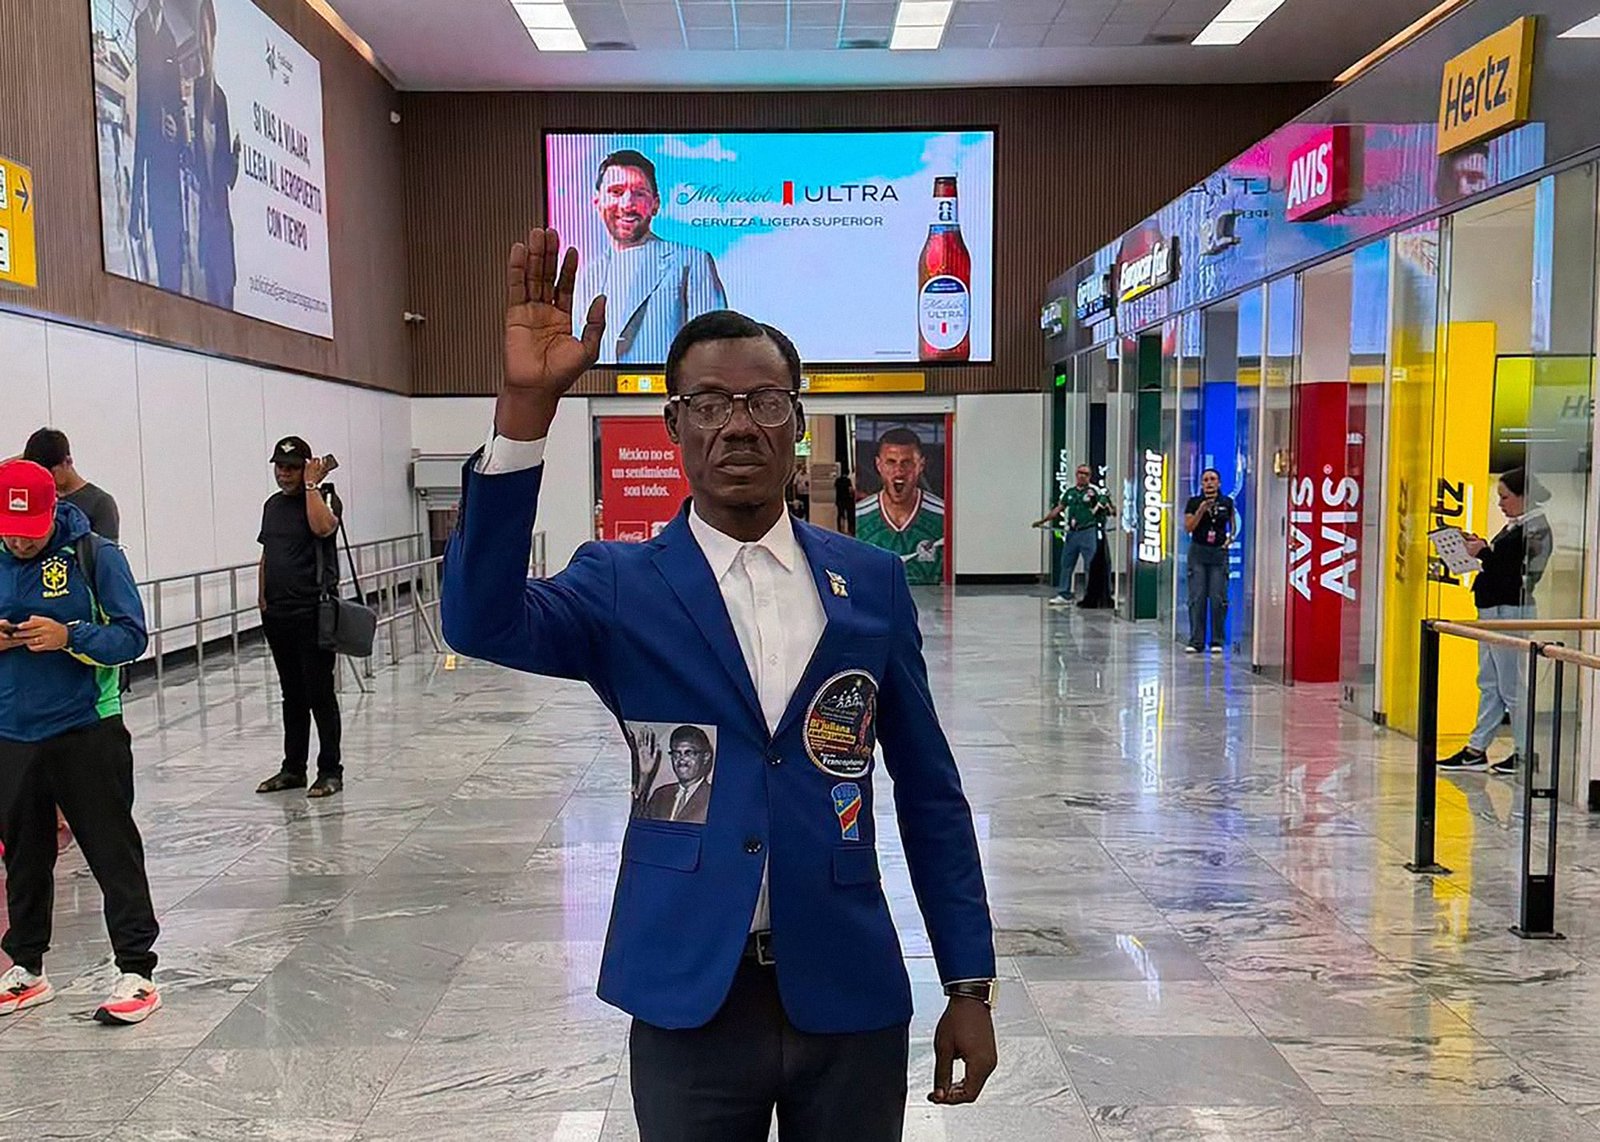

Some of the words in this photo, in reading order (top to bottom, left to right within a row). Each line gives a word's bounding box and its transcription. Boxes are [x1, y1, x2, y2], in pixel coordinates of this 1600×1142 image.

[253, 101, 262, 135] SI
[262, 106, 276, 143] VAS
[277, 118, 284, 148] A
[1444, 54, 1510, 131] Hertz
[243, 144, 268, 186] LLEGA
[269, 159, 280, 192] AL
[280, 165, 322, 214] AEROPUERTO
[676, 182, 772, 205] Michelob
[804, 185, 899, 202] ULTRA
[1287, 142, 1329, 209] AVIS
[266, 205, 282, 239] CON
[282, 213, 308, 251] TIEMPO
[691, 216, 757, 227] CERVEZA
[759, 216, 810, 227] LIGERA
[812, 216, 884, 227] SUPERIOR
[619, 448, 649, 461] México
[651, 450, 663, 460] no
[664, 450, 674, 460] es
[1139, 449, 1162, 563] Europcar
[1290, 477, 1313, 600] AVIS
[1428, 478, 1464, 585] Hrtz
